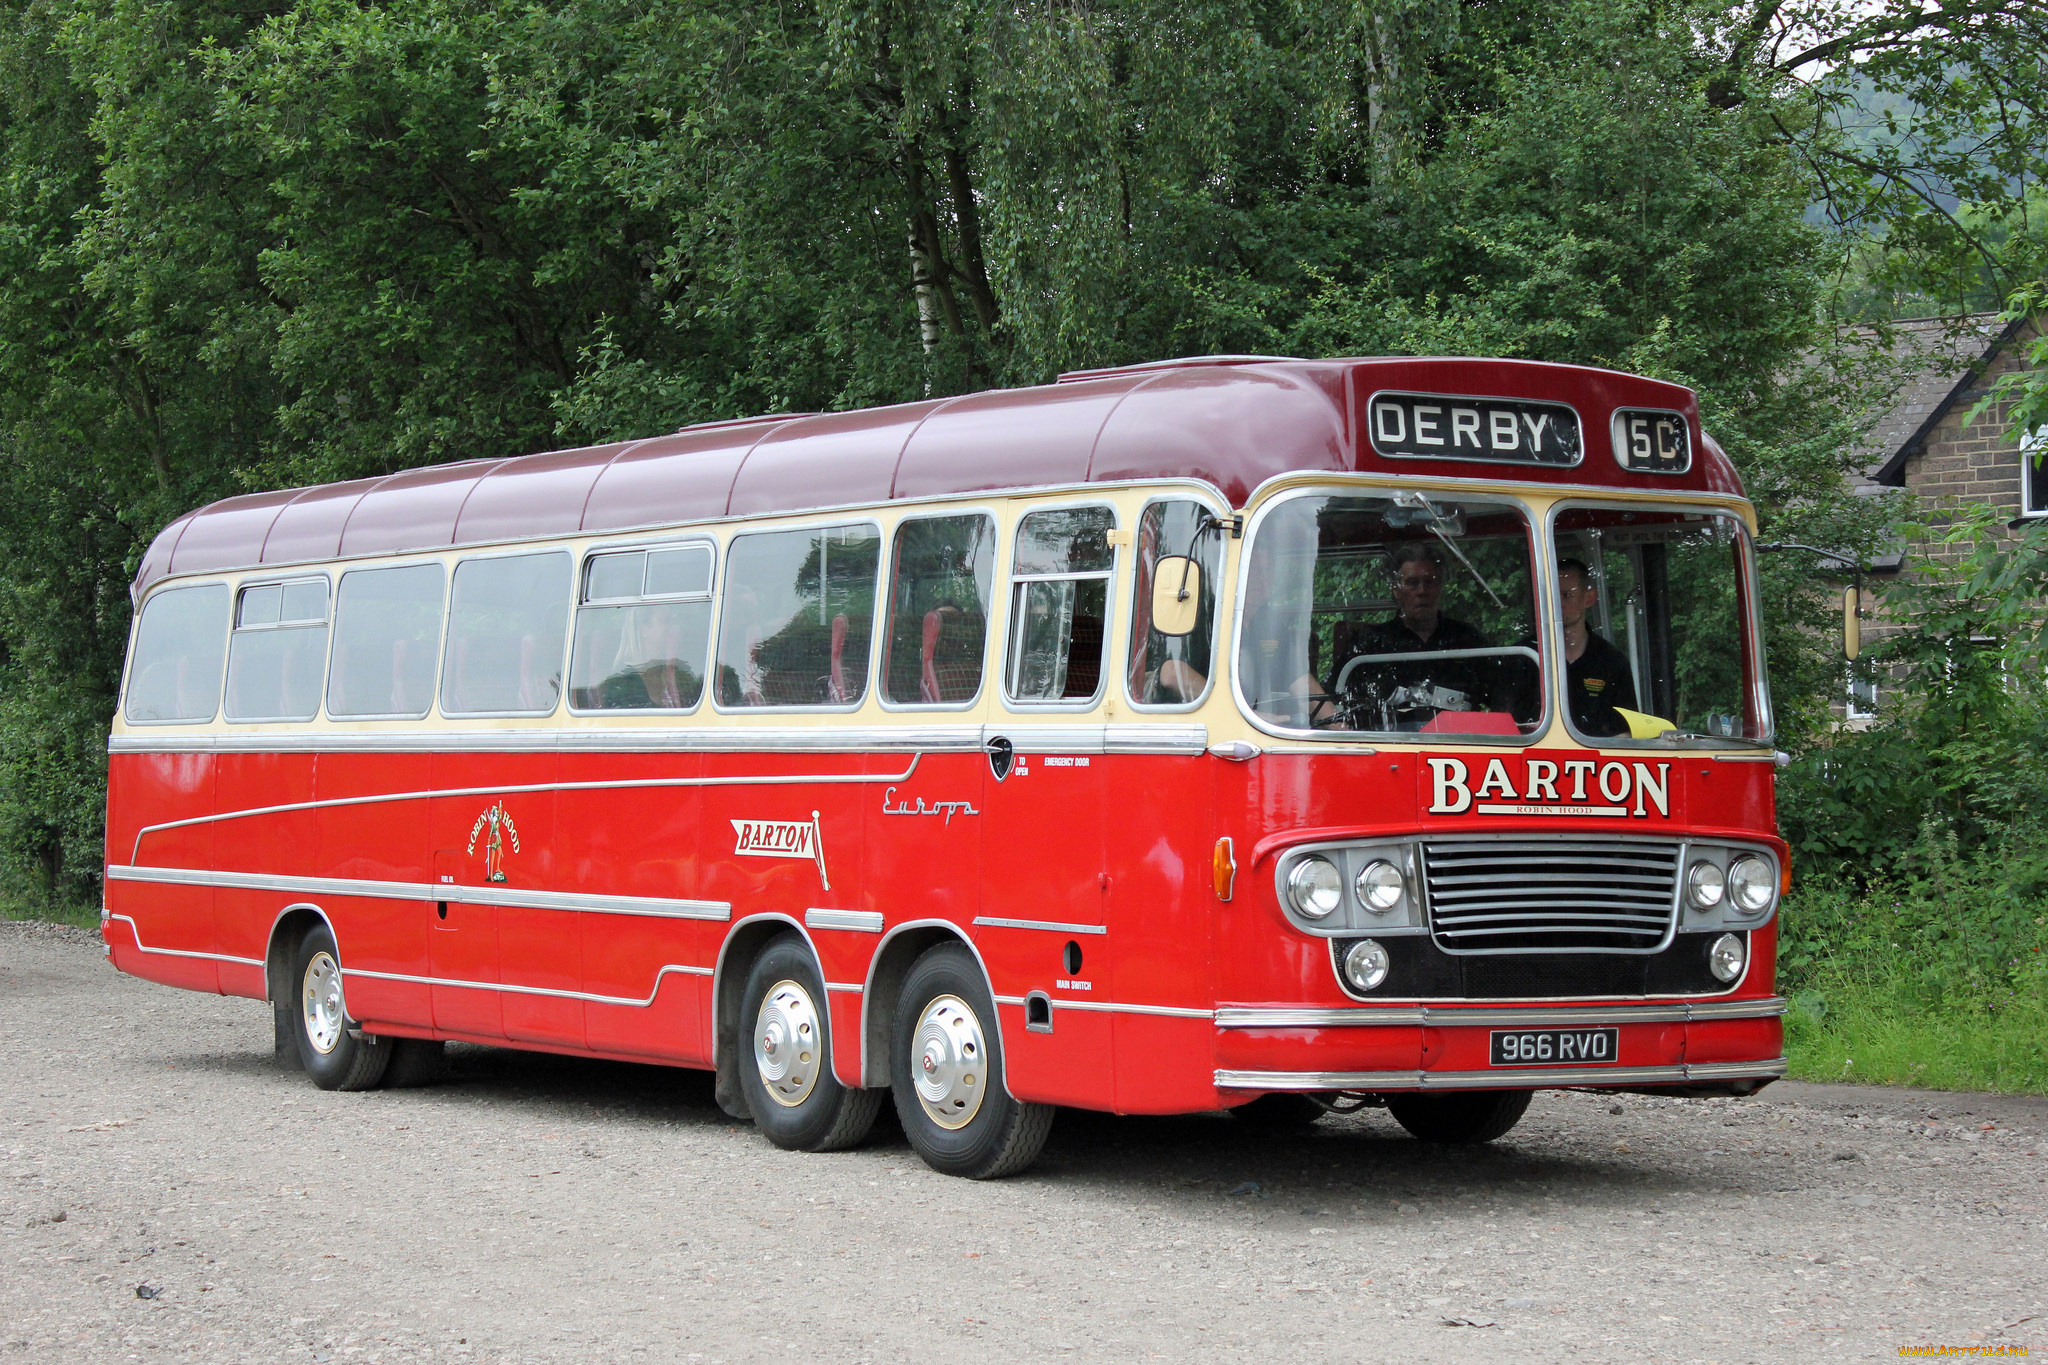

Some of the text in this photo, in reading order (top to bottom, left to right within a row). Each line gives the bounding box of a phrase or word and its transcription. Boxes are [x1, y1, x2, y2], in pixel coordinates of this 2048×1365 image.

[1375, 402, 1549, 452] DERBY
[1015, 767, 1029, 776] OPEN
[1018, 757, 1026, 765] TO
[1044, 757, 1090, 767] EMERGENCY DOOR
[1427, 758, 1671, 817] BARTON
[882, 786, 980, 826] Europa
[1516, 806, 1553, 814] ROBIN
[467, 808, 520, 857] ROBIN HOOD
[738, 823, 812, 853] BARTON
[1056, 979, 1092, 990] MAIN SWITCH
[1502, 1032, 1608, 1060] 966 RVO
